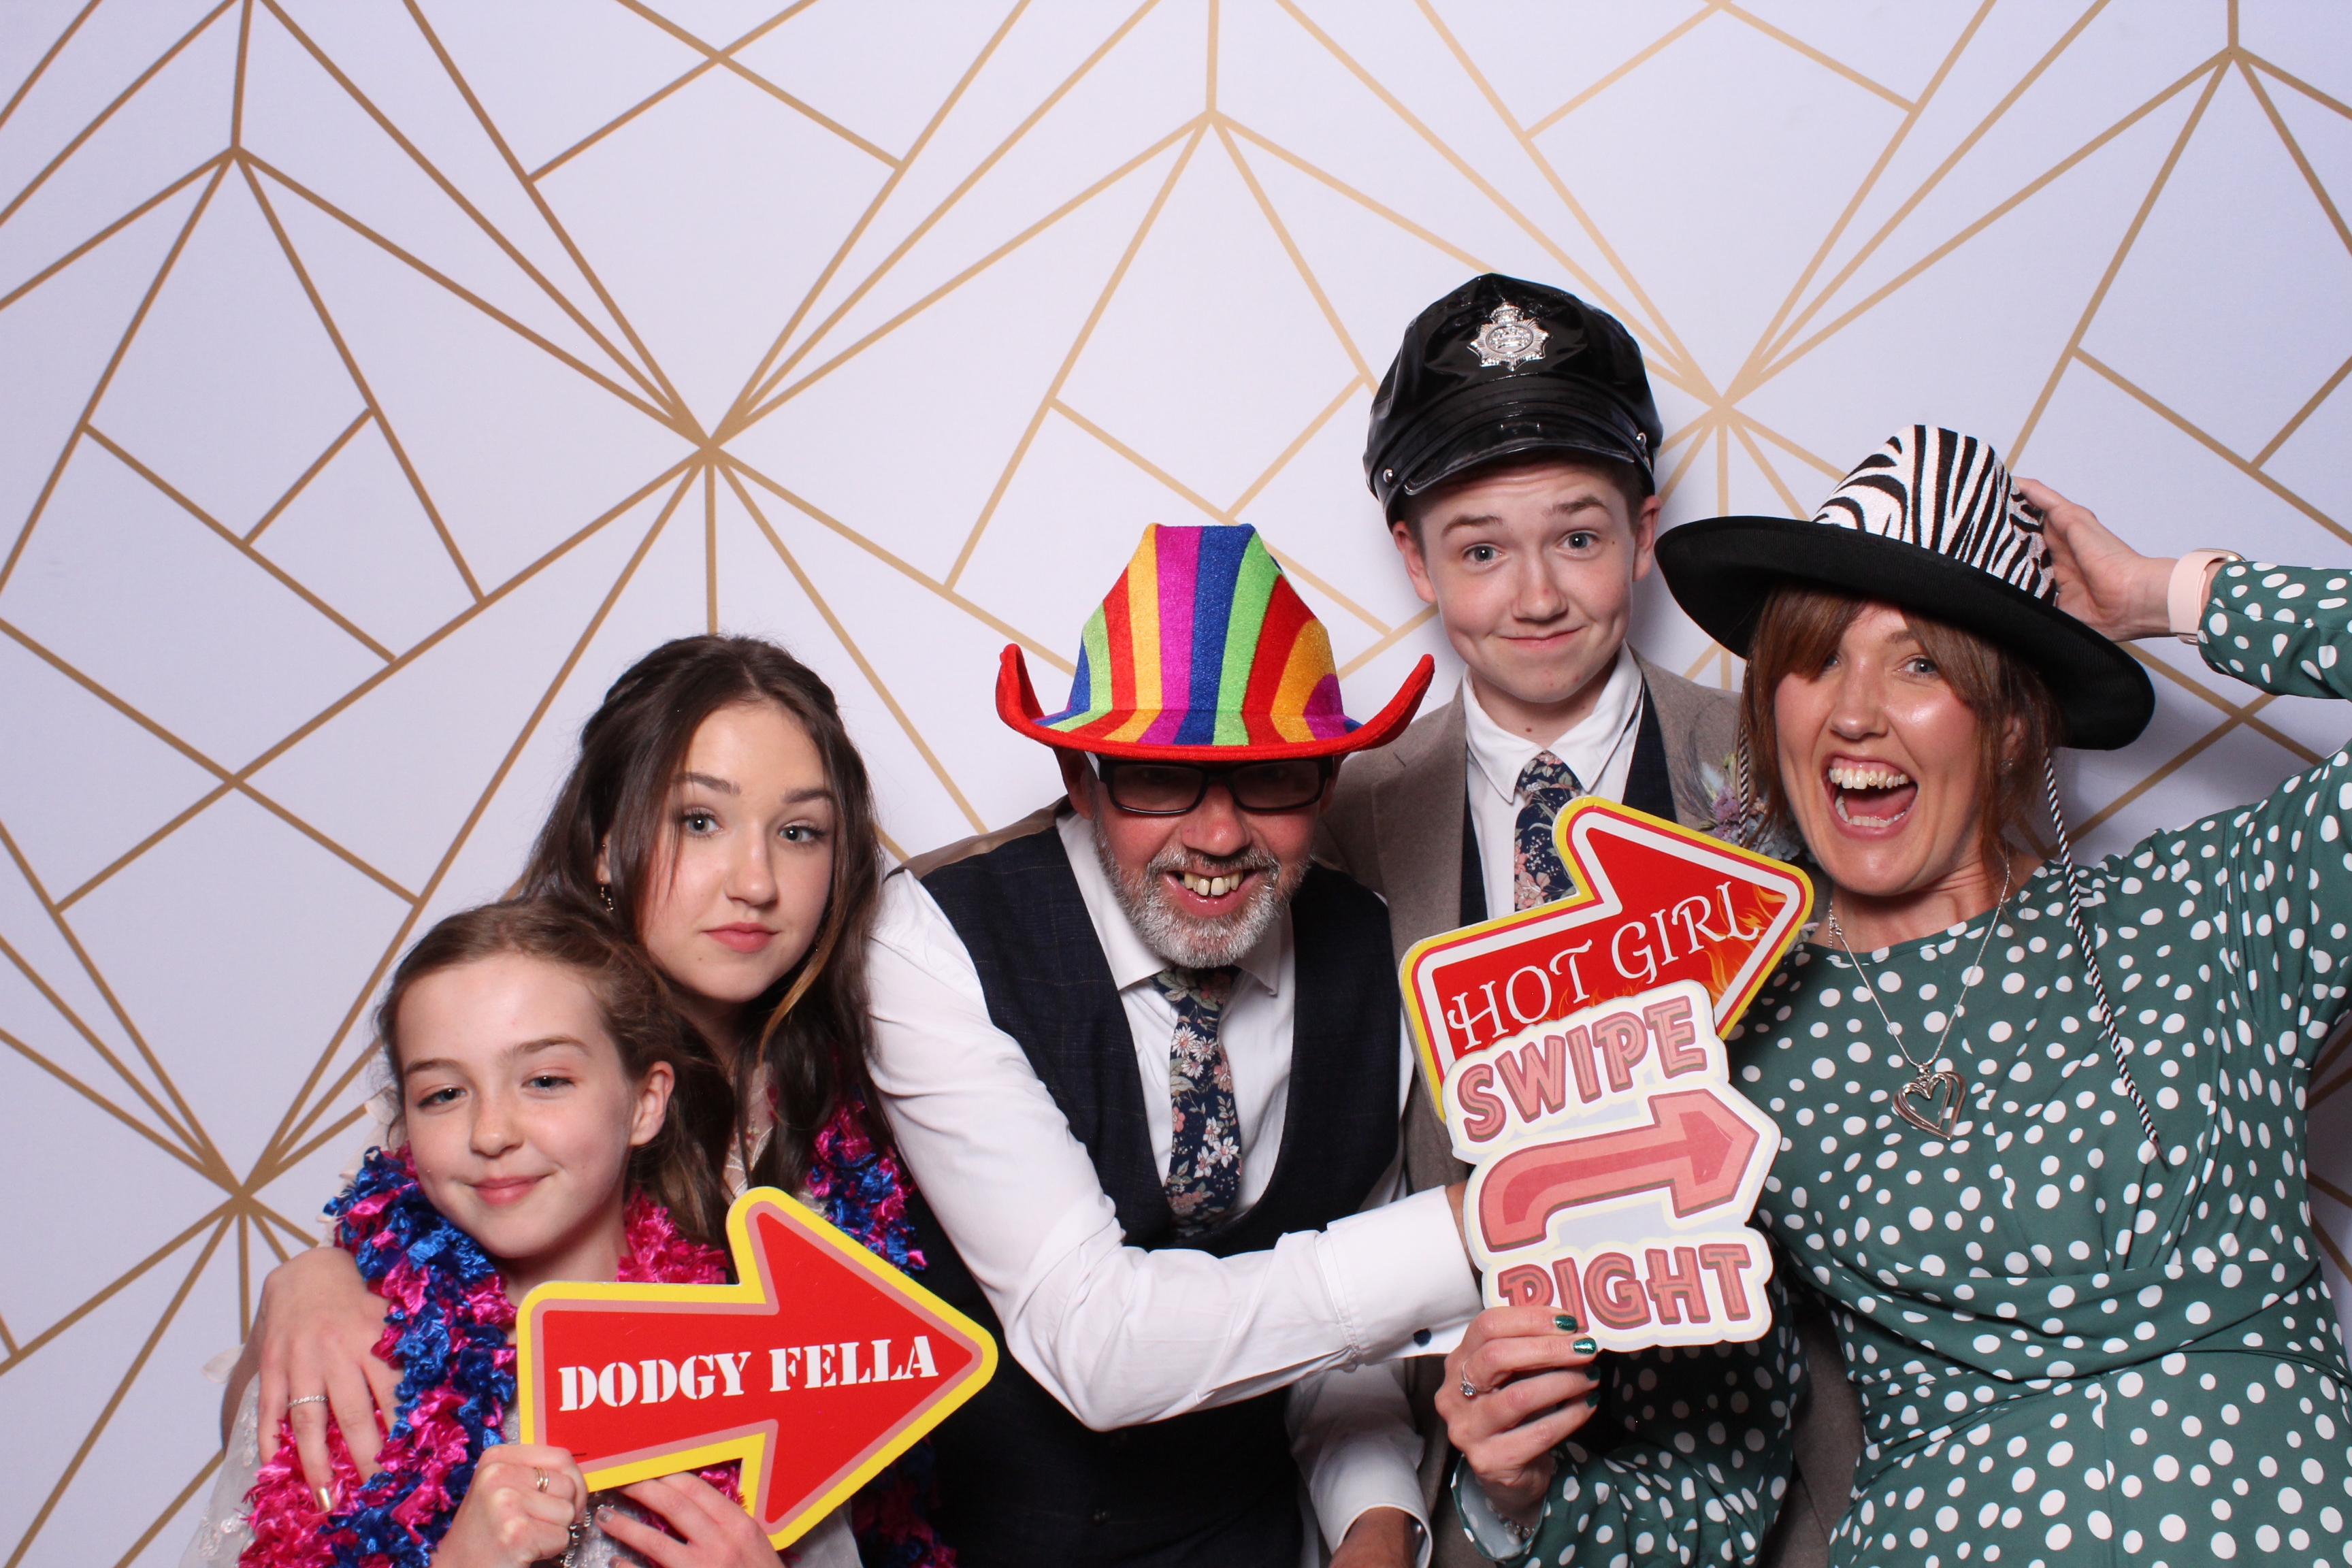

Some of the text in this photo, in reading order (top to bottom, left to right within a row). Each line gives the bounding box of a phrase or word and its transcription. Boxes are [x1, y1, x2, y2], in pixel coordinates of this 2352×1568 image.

[1447, 881, 1760, 1049] HOT GIRL
[1457, 996, 1706, 1142] SWIPE
[558, 1335, 938, 1411] DODGY FELLA
